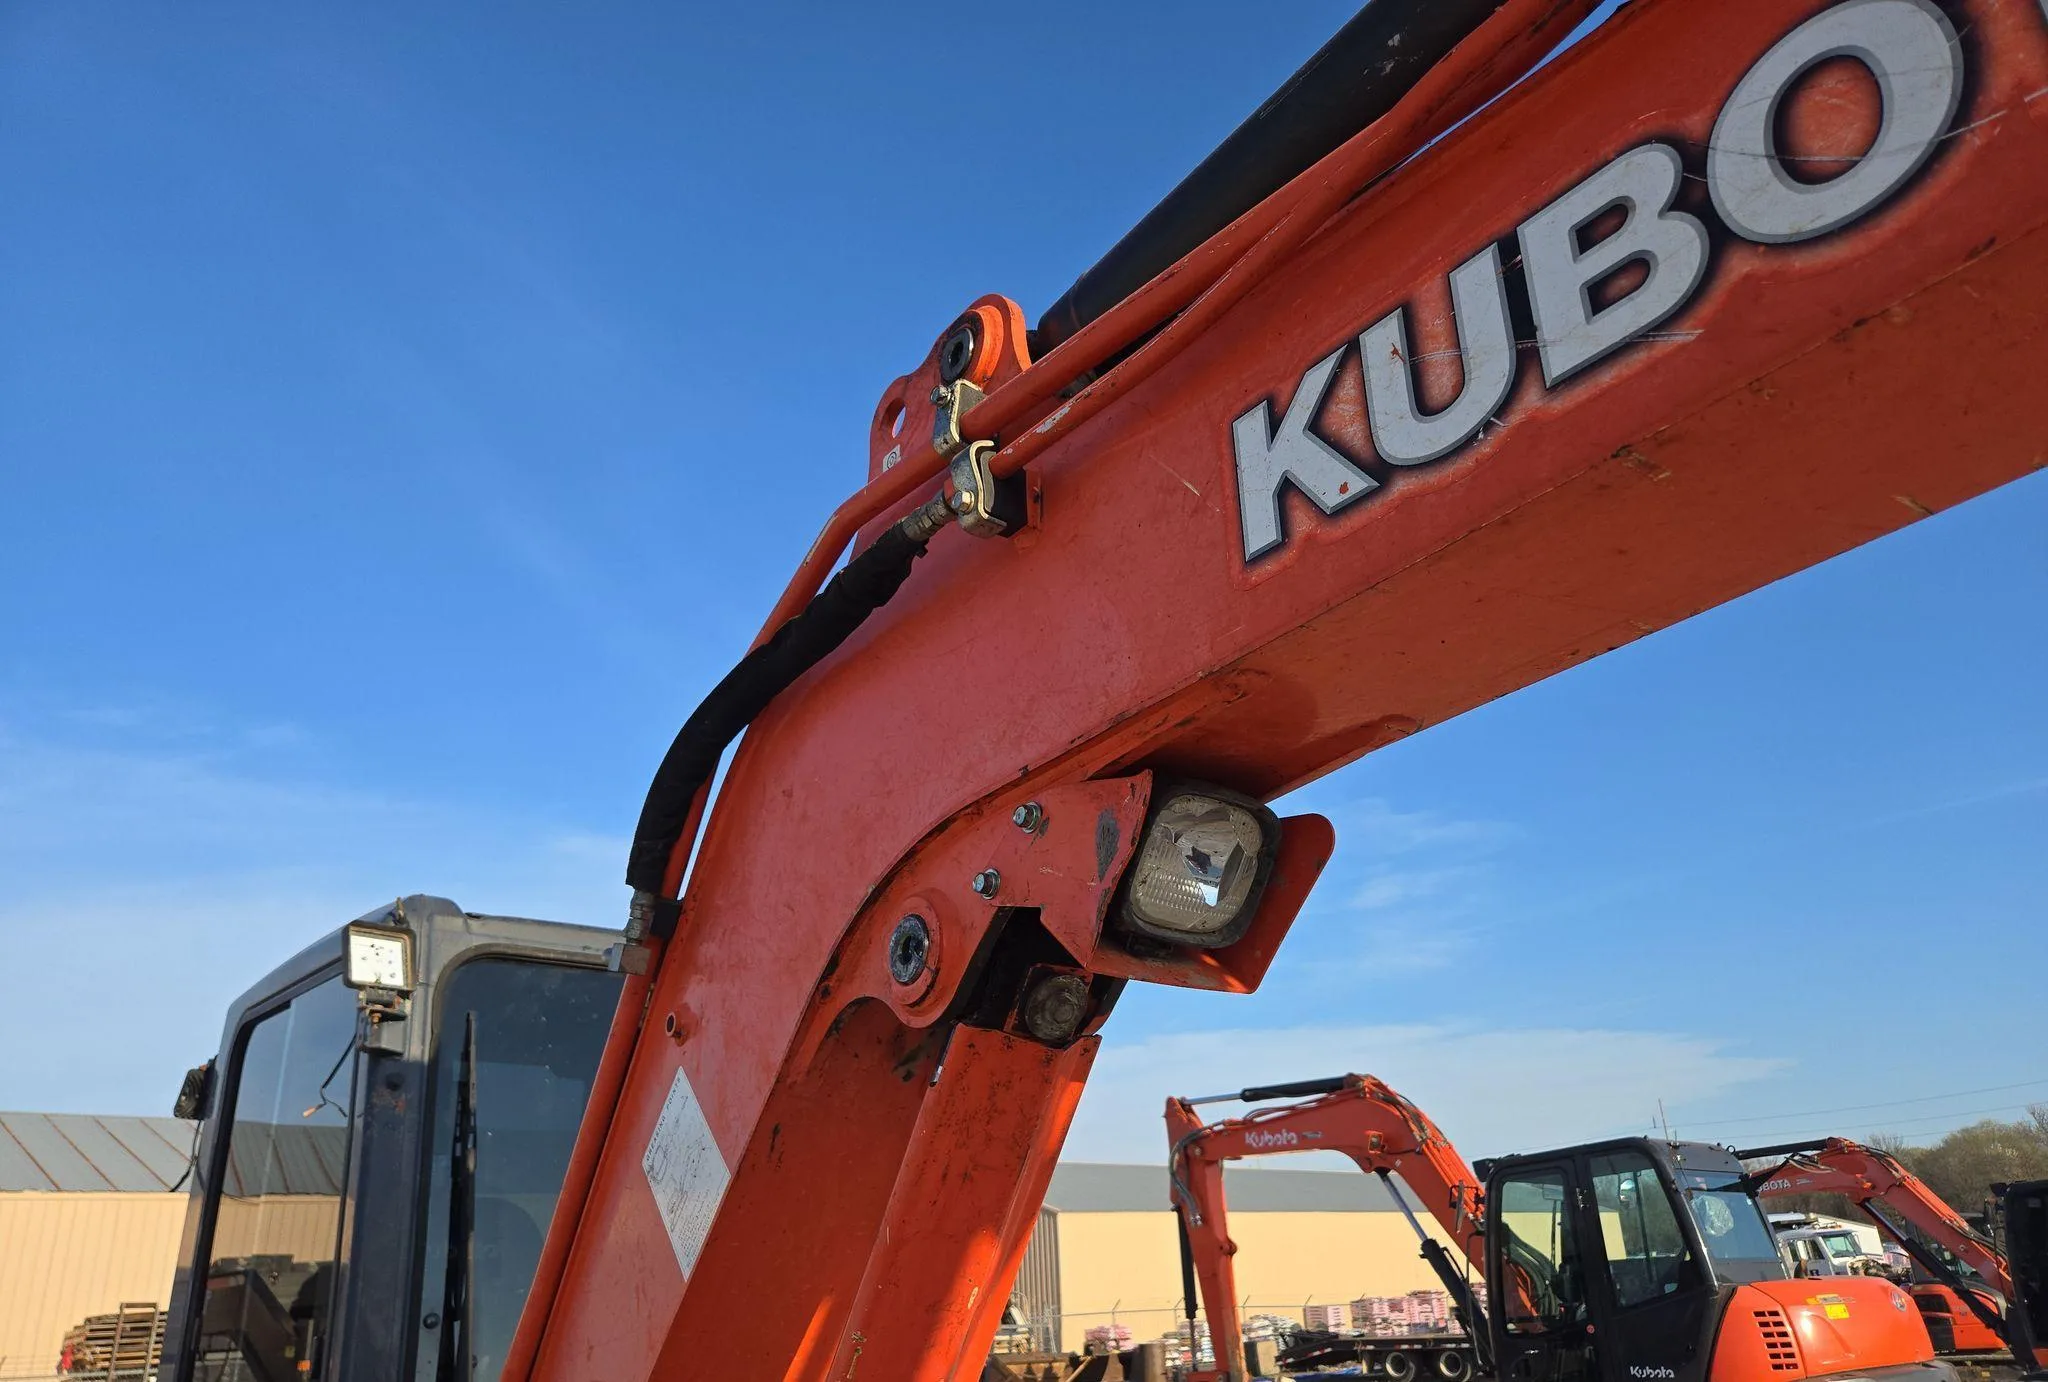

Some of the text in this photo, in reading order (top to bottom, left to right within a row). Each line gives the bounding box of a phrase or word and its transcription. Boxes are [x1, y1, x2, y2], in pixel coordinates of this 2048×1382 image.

[1232, 0, 2048, 562] KUBO
[1245, 1128, 1298, 1148] Kubota
[1630, 1366, 1675, 1378] Kubota
